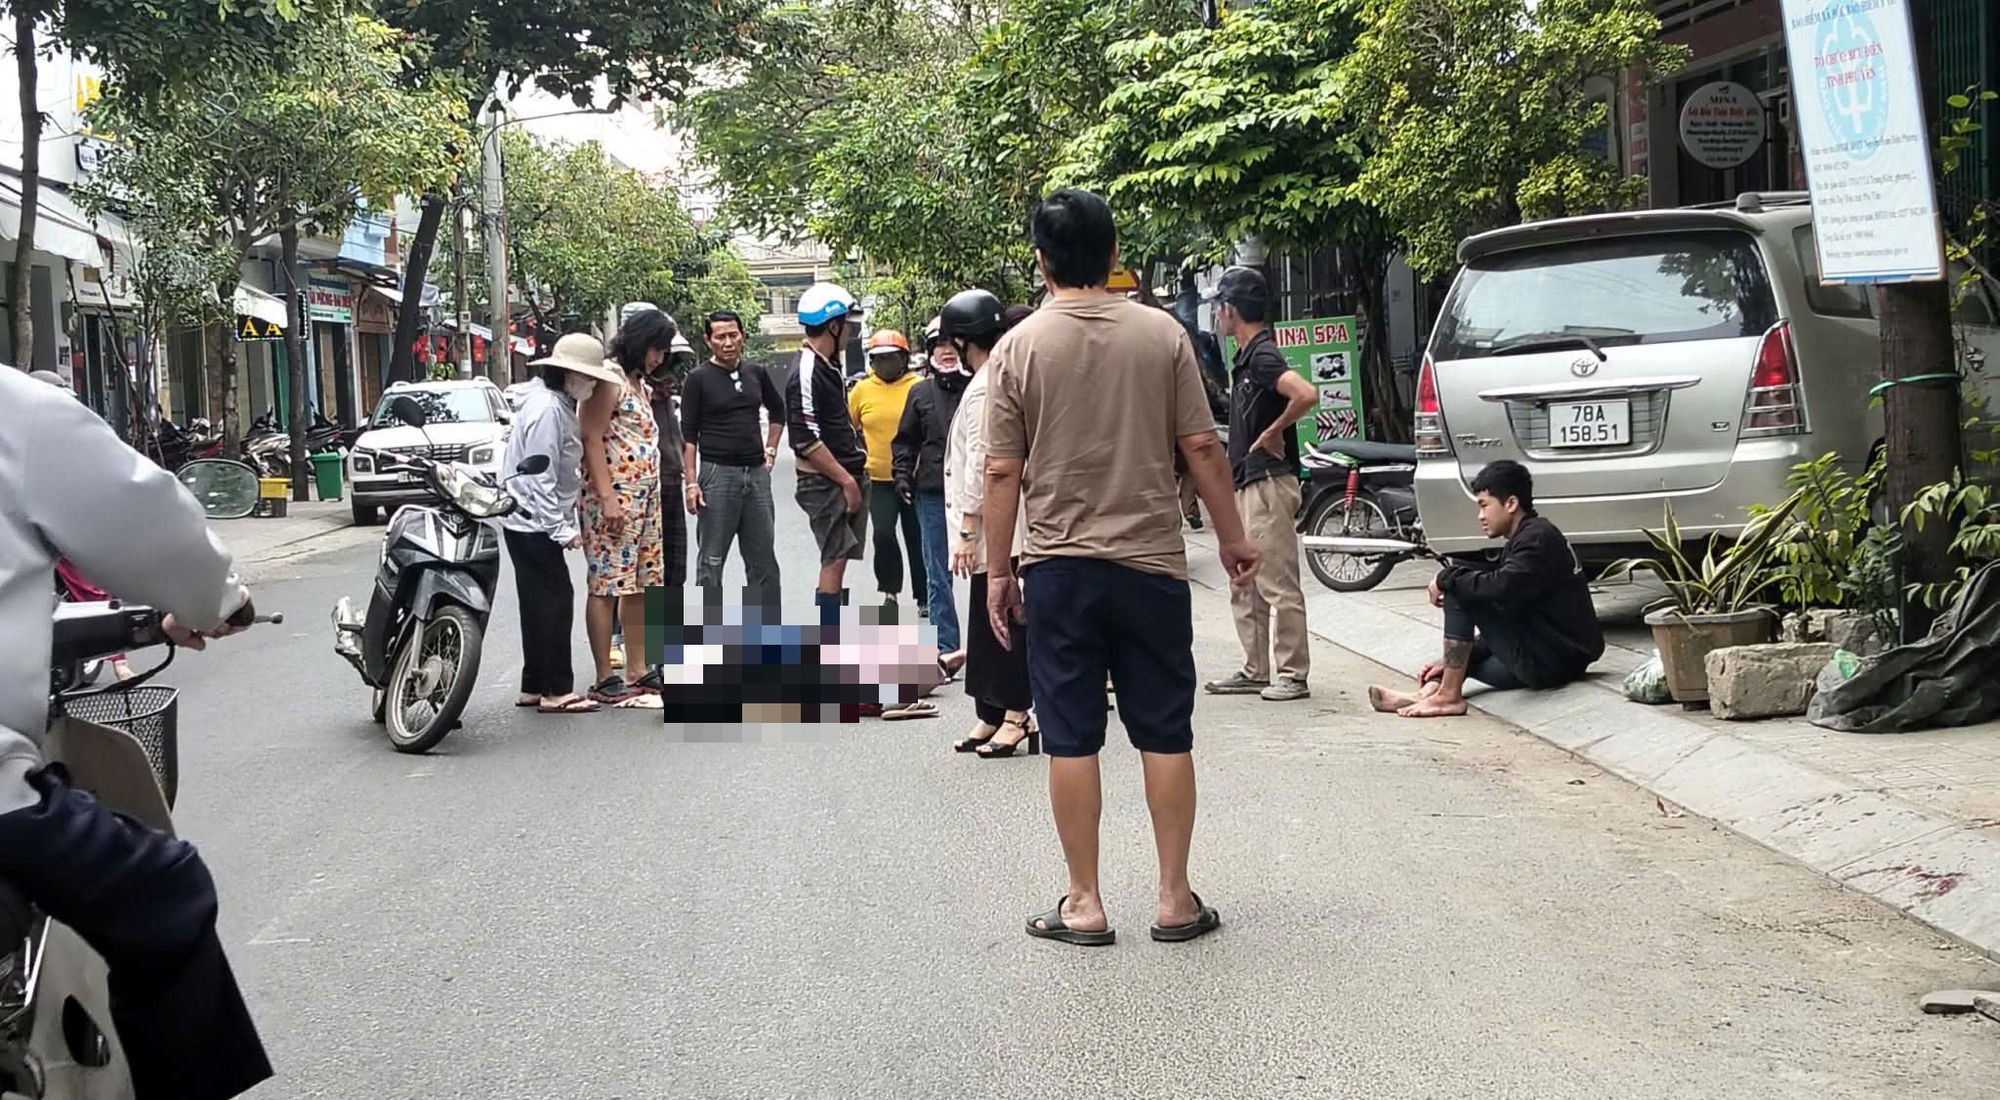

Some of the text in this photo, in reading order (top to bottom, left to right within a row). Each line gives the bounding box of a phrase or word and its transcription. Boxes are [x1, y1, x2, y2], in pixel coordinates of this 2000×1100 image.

[1710, 96, 1737, 104] MINA
[1273, 322, 1350, 349] INA SPA
[1571, 404, 1605, 423] 78A
[1560, 423, 1618, 443] 158.51
